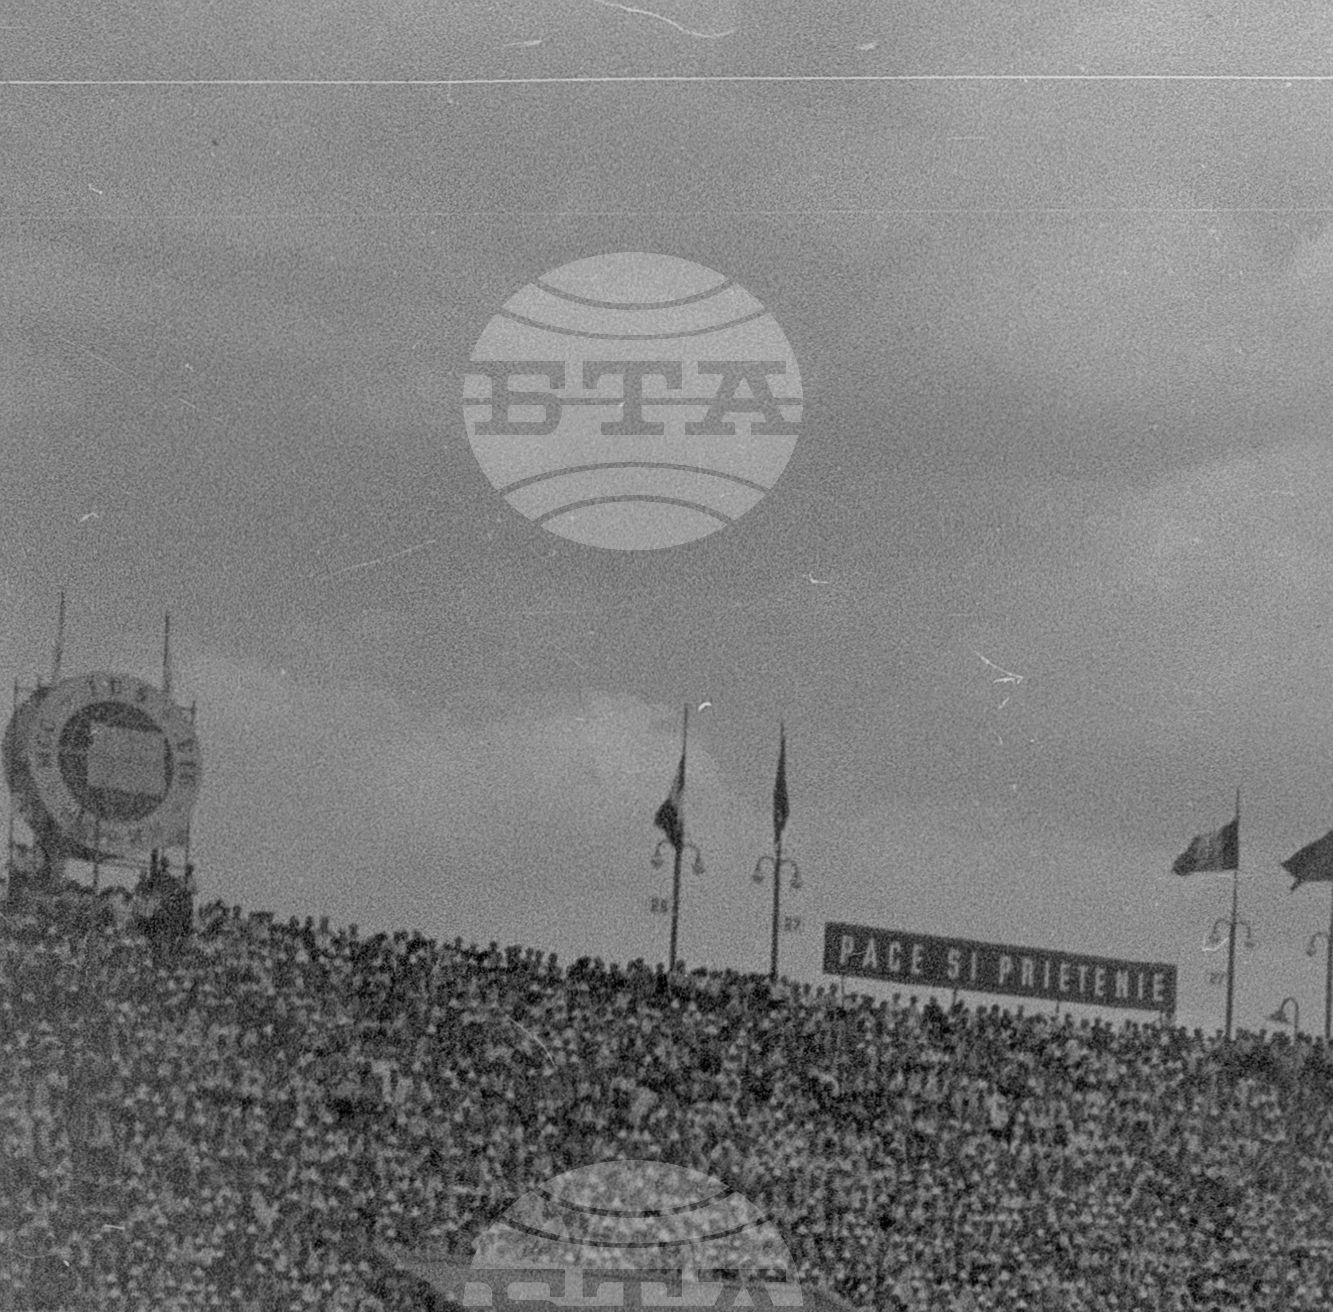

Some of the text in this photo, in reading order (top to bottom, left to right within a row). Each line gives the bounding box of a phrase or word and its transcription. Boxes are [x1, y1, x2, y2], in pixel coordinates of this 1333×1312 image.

[839, 934, 1166, 1001] PACE SI PRIETENIE
